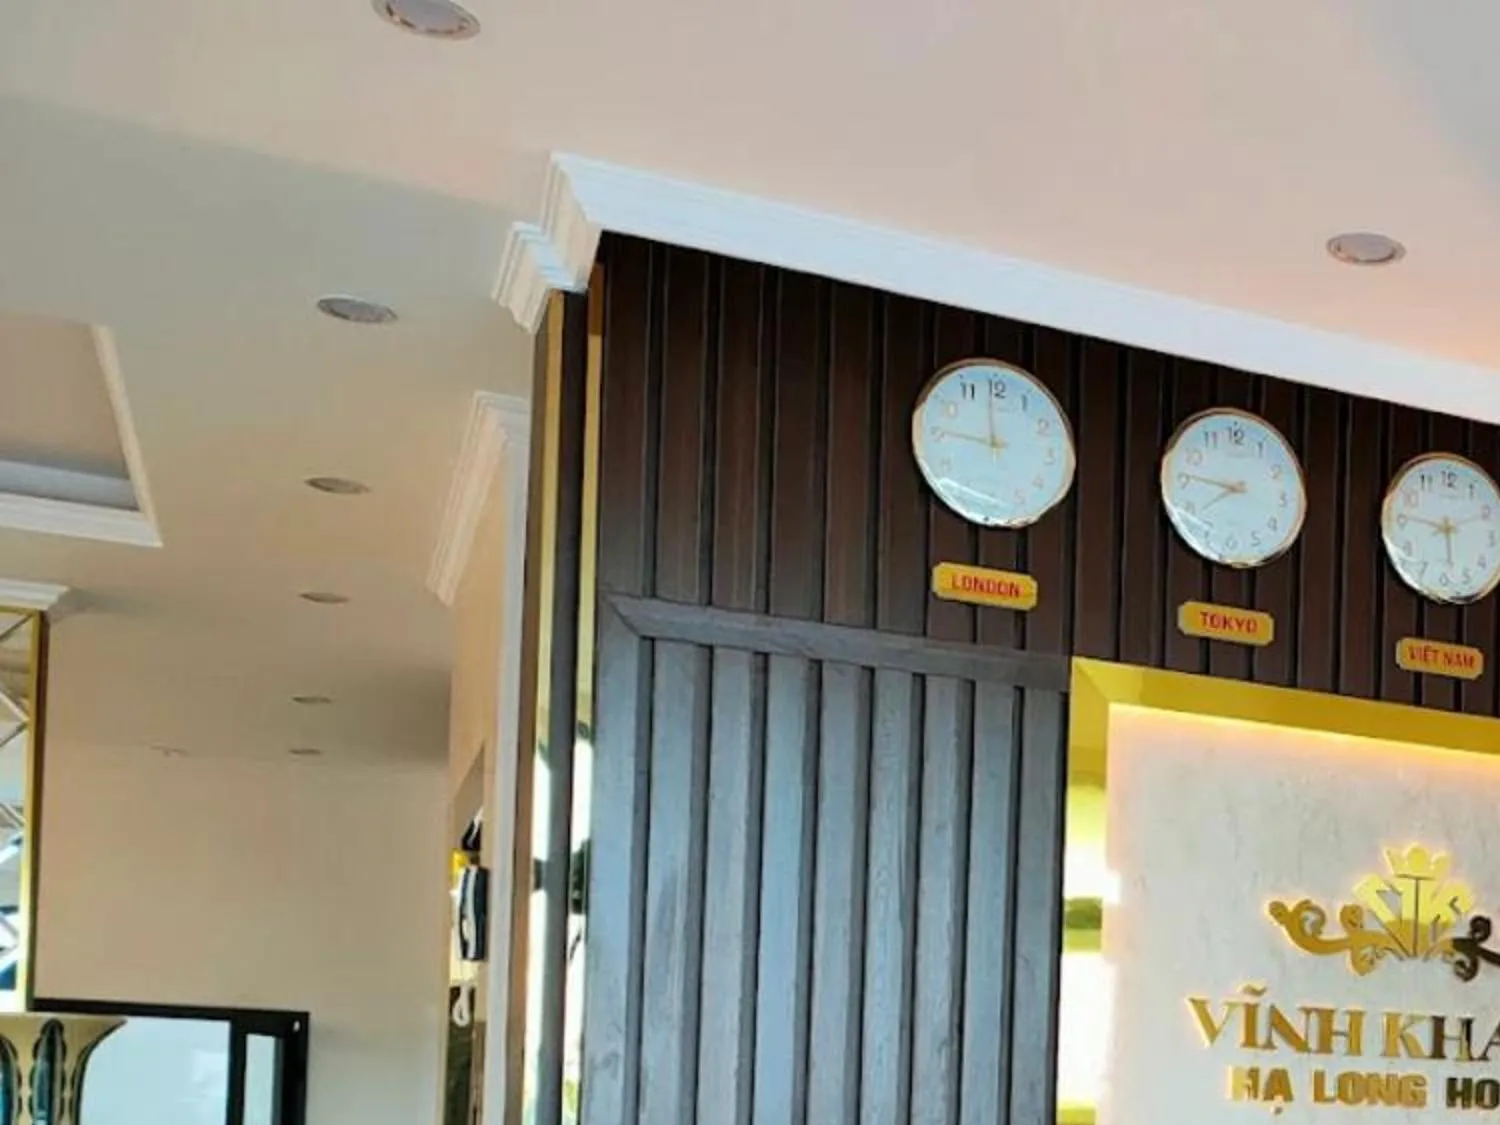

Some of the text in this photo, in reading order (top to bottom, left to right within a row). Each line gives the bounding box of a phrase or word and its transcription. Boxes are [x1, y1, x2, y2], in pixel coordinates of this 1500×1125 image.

[960, 382, 975, 400] 11
[988, 379, 1006, 399] 12
[1204, 431, 1217, 448] 11
[1227, 427, 1244, 445] 12
[1420, 474, 1433, 492] 11
[1441, 470, 1457, 488] 12
[952, 574, 1022, 597] LONDON
[1200, 611, 1257, 634] TOKYO
[1443, 651, 1475, 670] NAM
[1186, 984, 1366, 1057] VĨNH
[1229, 1066, 1294, 1114] HẠ
[1313, 1071, 1428, 1109] LONG
